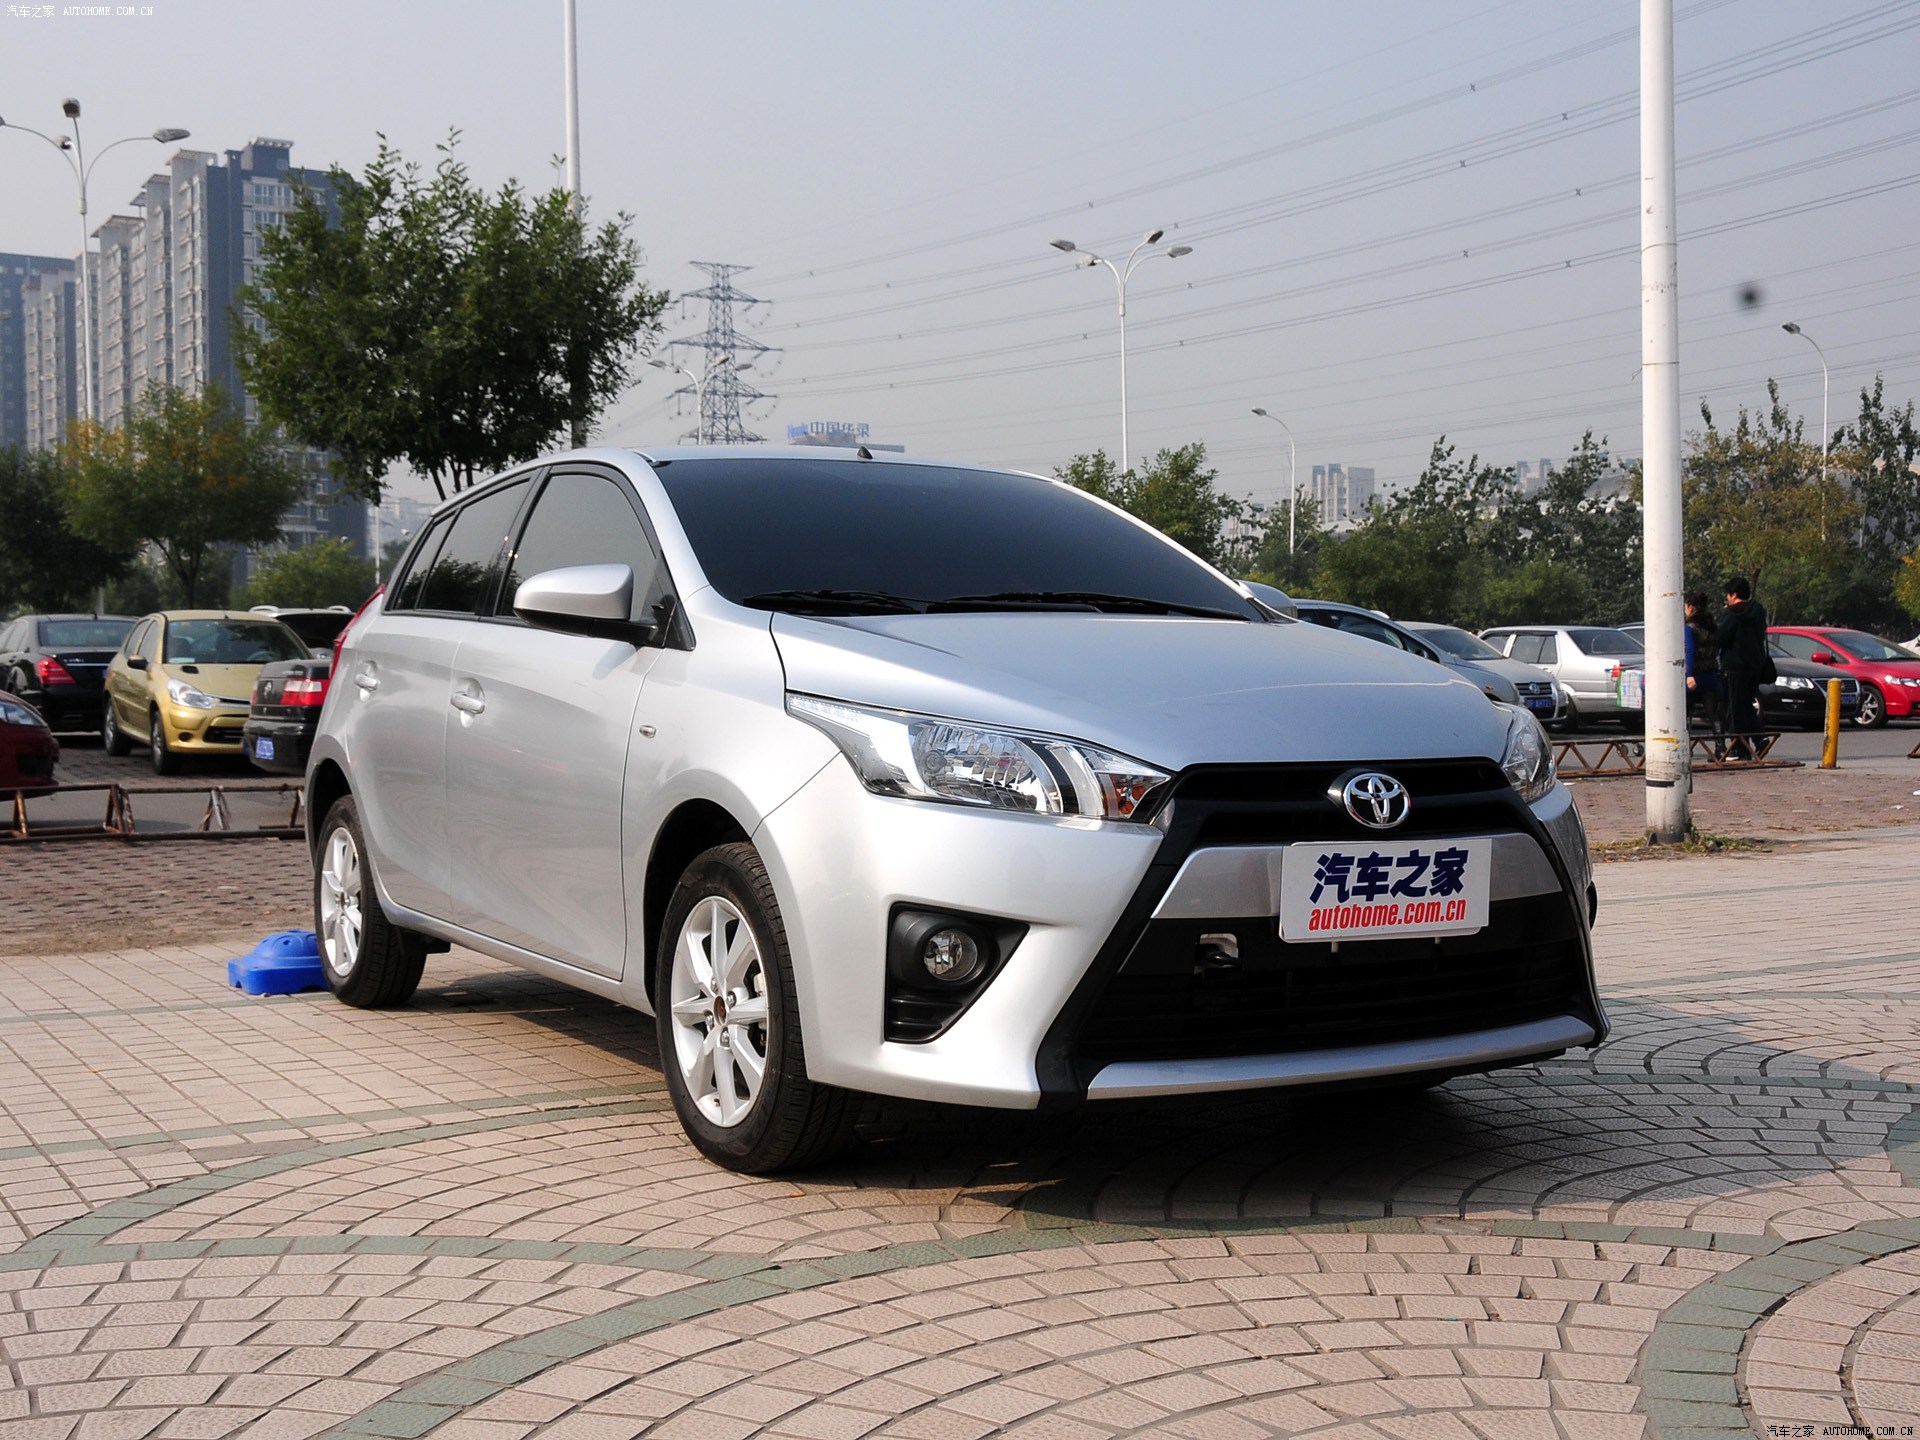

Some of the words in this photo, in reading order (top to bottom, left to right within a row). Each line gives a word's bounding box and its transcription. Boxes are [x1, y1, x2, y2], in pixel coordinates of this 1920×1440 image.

[1309, 847, 1469, 904] 汽车之家
[1308, 899, 1467, 931] autohome.com.cn
